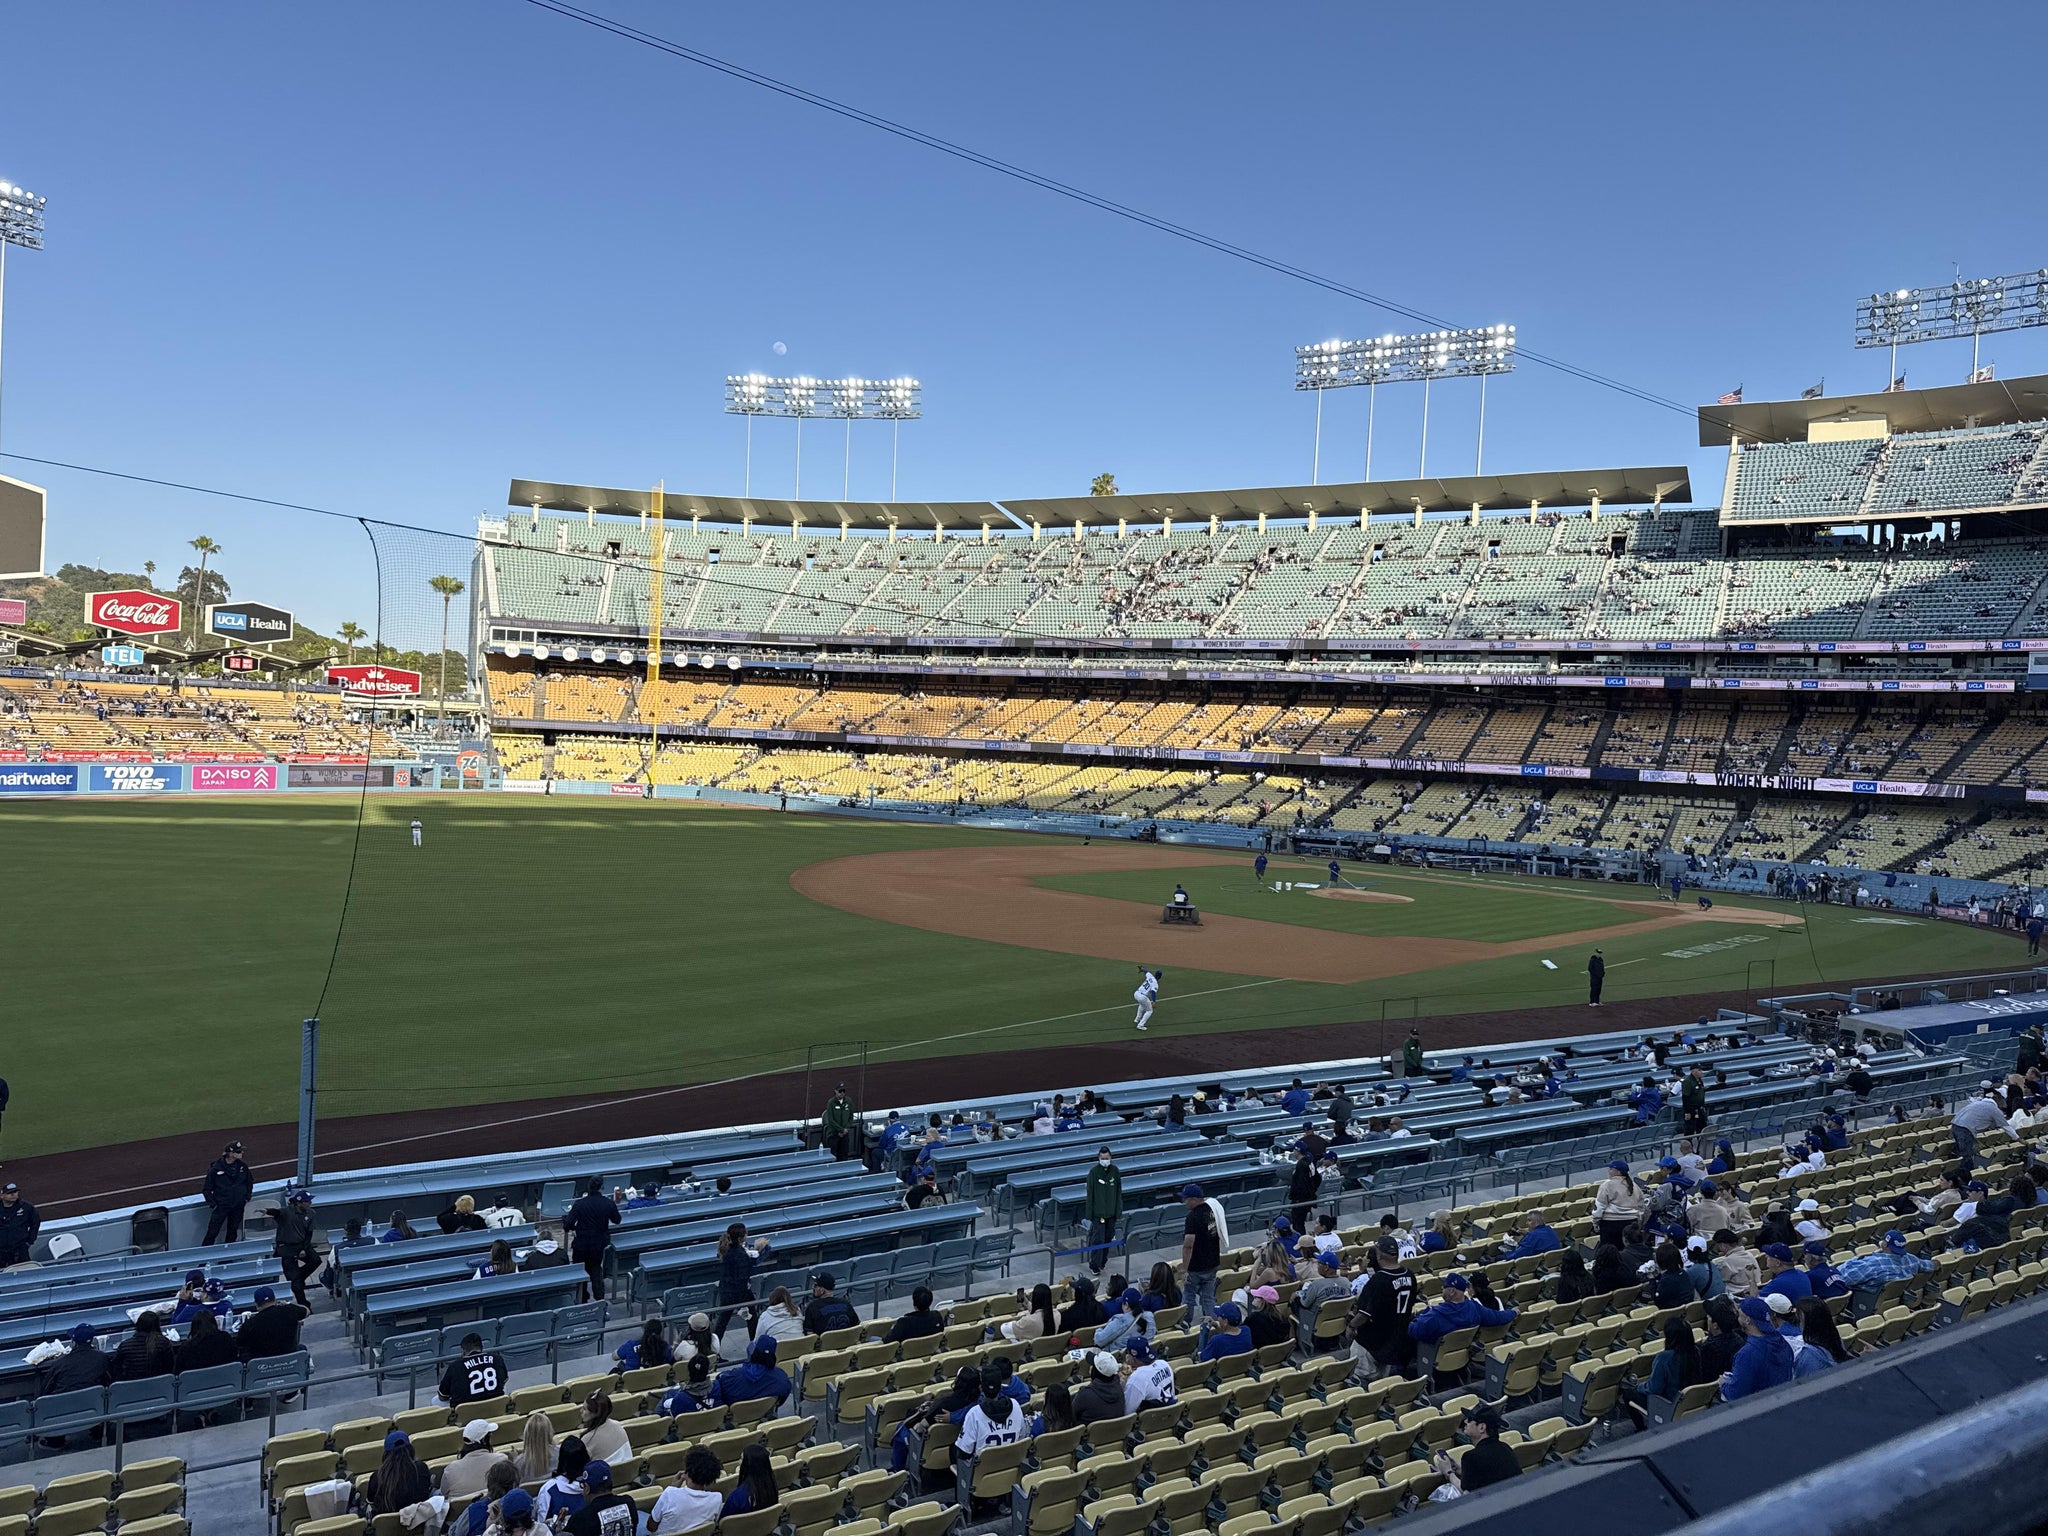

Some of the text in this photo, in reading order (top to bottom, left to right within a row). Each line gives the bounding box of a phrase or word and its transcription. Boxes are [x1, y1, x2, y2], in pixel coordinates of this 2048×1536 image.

[99, 599, 173, 625] Coca-Cola
[216, 615, 286, 631] UCLA Health
[108, 649, 140, 663] TEL
[337, 676, 412, 692] Budweiser
[1491, 676, 1531, 685] WOMEN'S
[667, 725, 731, 737] WOMEN'S NIGHT
[1113, 745, 1152, 758] WOMEN'S
[1155, 746, 1180, 759] NIGHT
[1222, 752, 1241, 760] Health
[463, 756, 479, 770] 76
[1390, 758, 1436, 771] WOMEN'S
[104, 767, 154, 778] TOYO
[201, 770, 250, 779] DAISO
[319, 768, 348, 776] WOMEN'S
[1548, 767, 1574, 776] Health
[396, 774, 408, 782] 76
[1716, 773, 1774, 788] WOMEN'S
[1778, 776, 1817, 790] NIGHT
[111, 779, 166, 790] TIRES
[612, 785, 643, 794] Yakult
[1856, 783, 1875, 791] UCLA
[1880, 784, 1907, 794] Health
[498, 1215, 514, 1227] 17
[1392, 1277, 1412, 1290] OHTANI
[1396, 1290, 1411, 1314] 17
[464, 1355, 494, 1369] MILLER
[468, 1367, 498, 1395] 28
[1152, 1367, 1171, 1387] OHTANI
[988, 1420, 1012, 1432] KEMP
